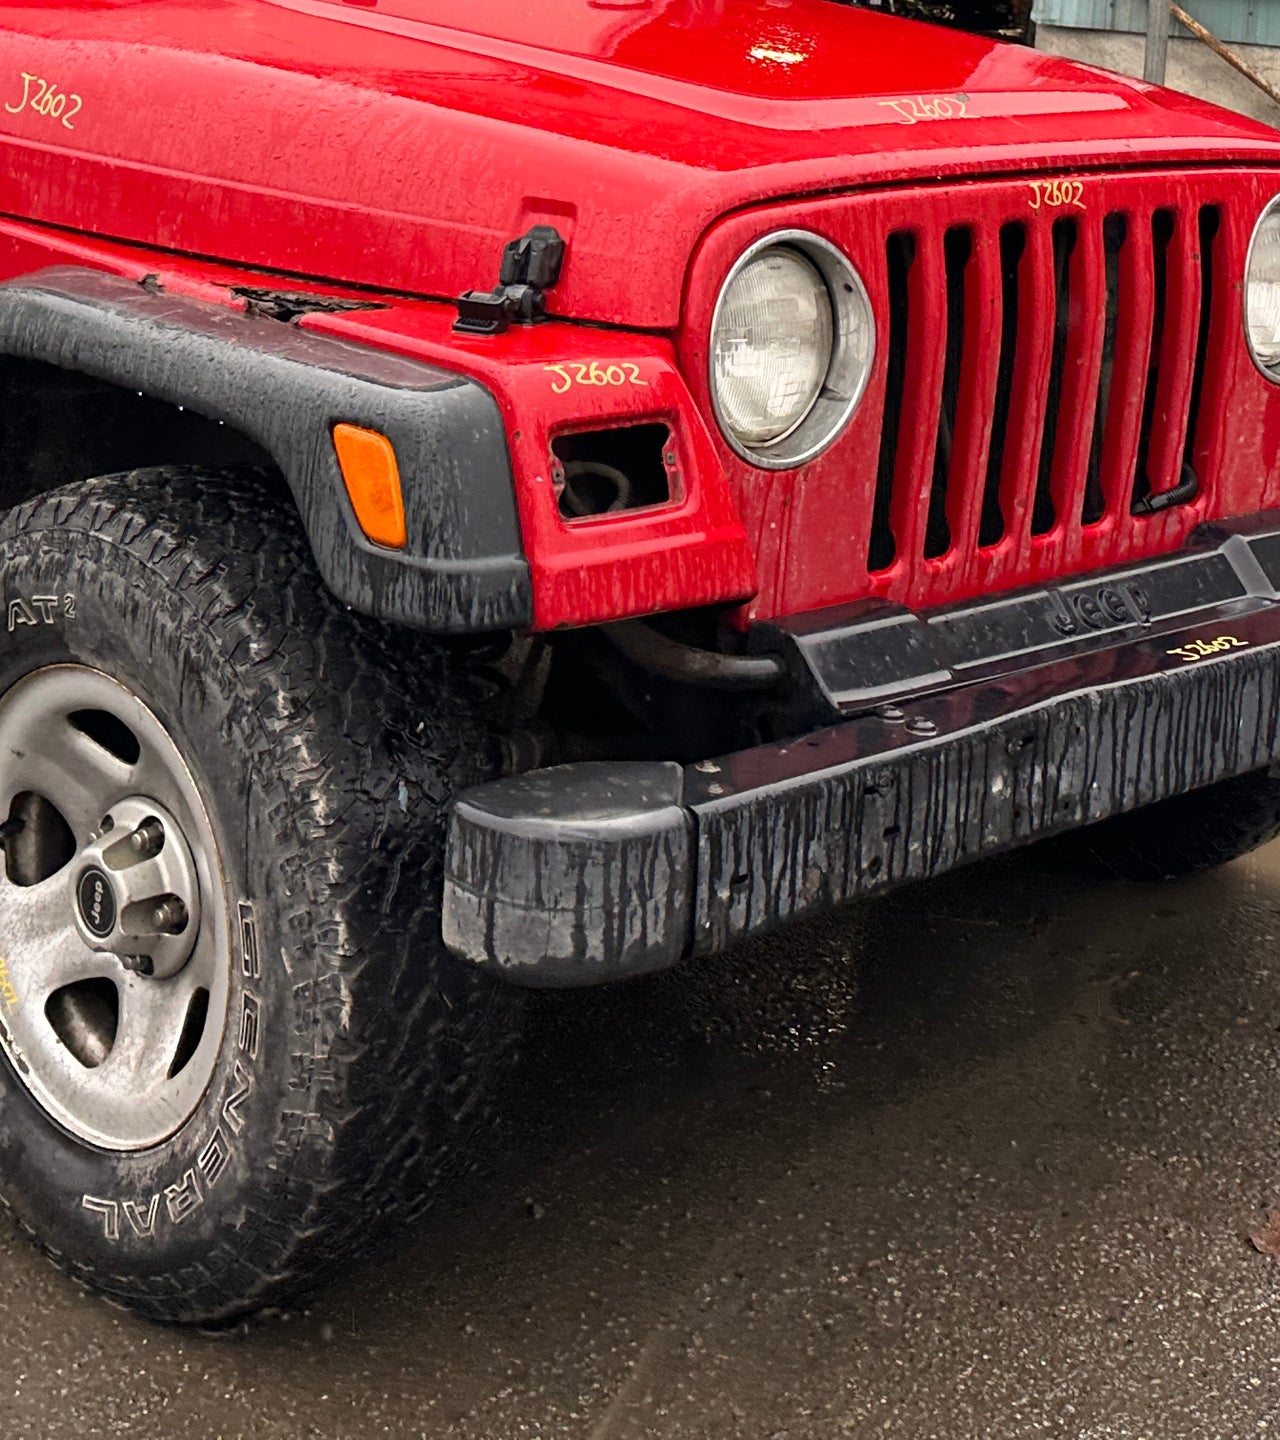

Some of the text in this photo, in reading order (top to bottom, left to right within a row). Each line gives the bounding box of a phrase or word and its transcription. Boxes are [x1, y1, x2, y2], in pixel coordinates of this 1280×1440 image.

[5, 71, 84, 130] J2602
[877, 96, 981, 126] J2602
[1027, 179, 1087, 210] J2602
[542, 362, 649, 394] J2602
[1046, 586, 1152, 637] Jeep
[1166, 635, 1250, 662] J2602
[91, 880, 104, 925] Jeep
[80, 900, 261, 1241] GENERAL
